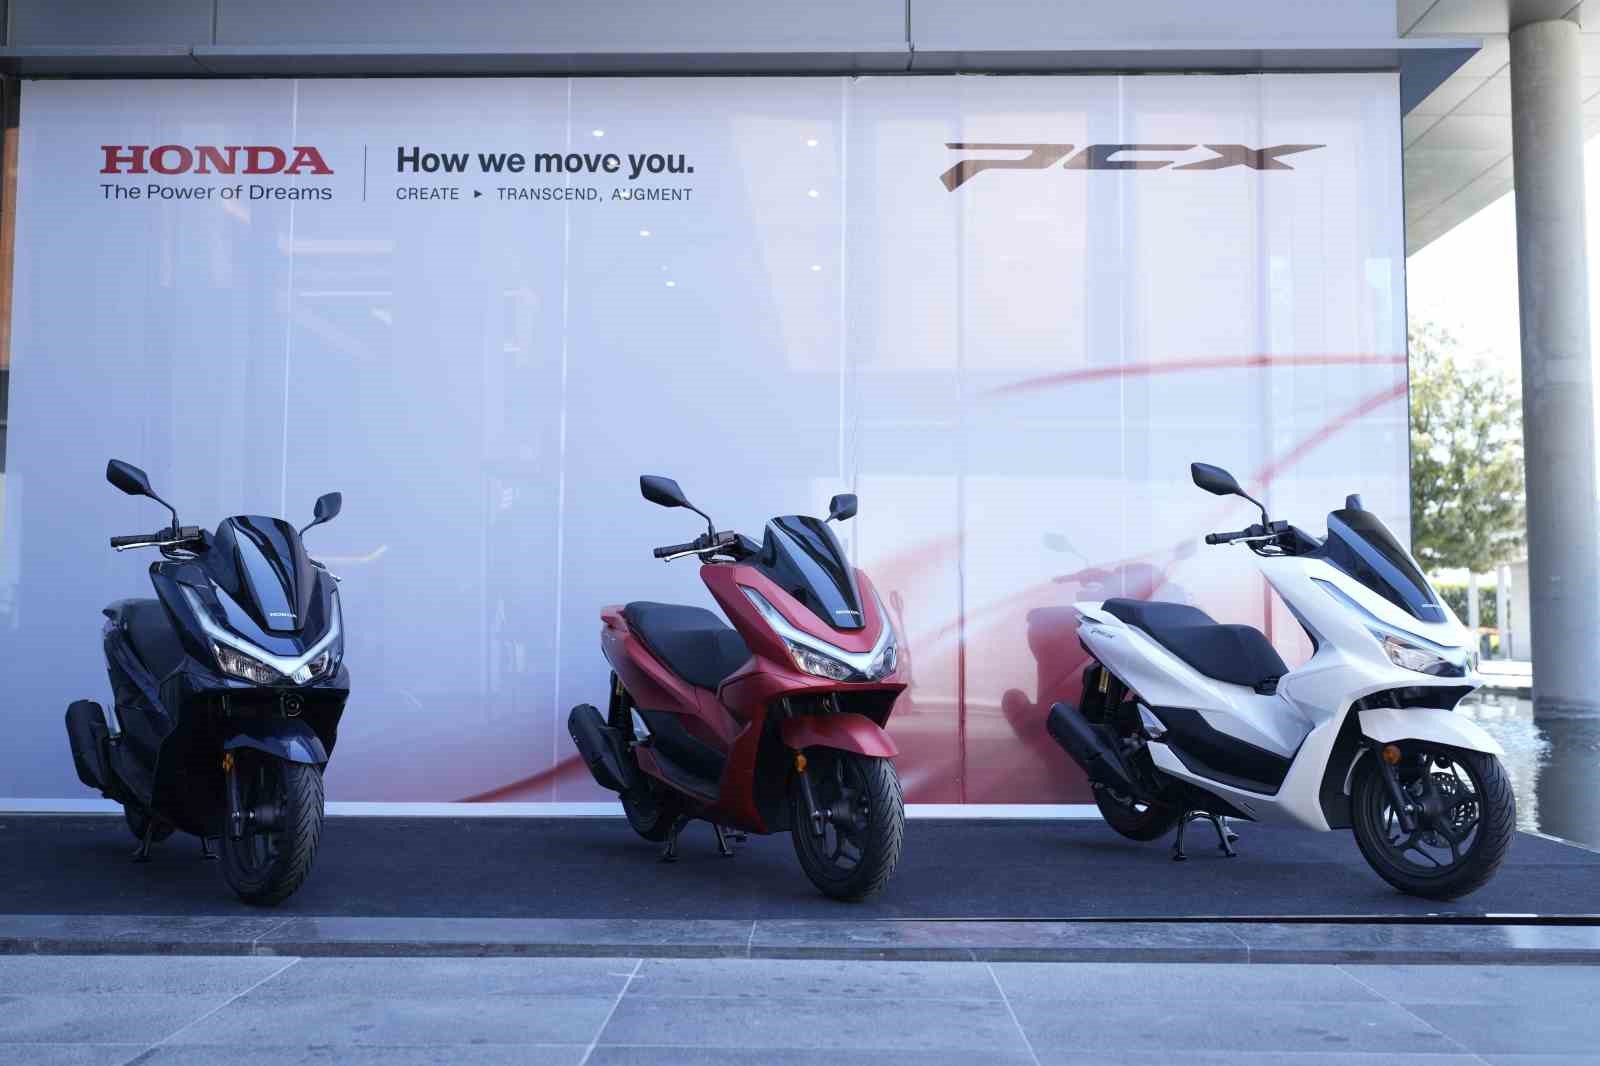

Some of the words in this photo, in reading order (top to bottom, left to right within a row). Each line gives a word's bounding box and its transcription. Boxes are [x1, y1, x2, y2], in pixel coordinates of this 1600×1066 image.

[99, 144, 335, 175] HONDA
[396, 146, 469, 173] How
[478, 152, 526, 173] we
[534, 152, 621, 173] move
[628, 153, 695, 180] you.
[939, 142, 1328, 193] PCX
[100, 184, 141, 200] The
[147, 184, 216, 200] Power
[220, 184, 244, 200] of
[249, 184, 333, 200] Dreams
[396, 187, 460, 200] CREATE
[497, 187, 602, 202] TRANSCEND,
[611, 187, 693, 201] AUGMENT
